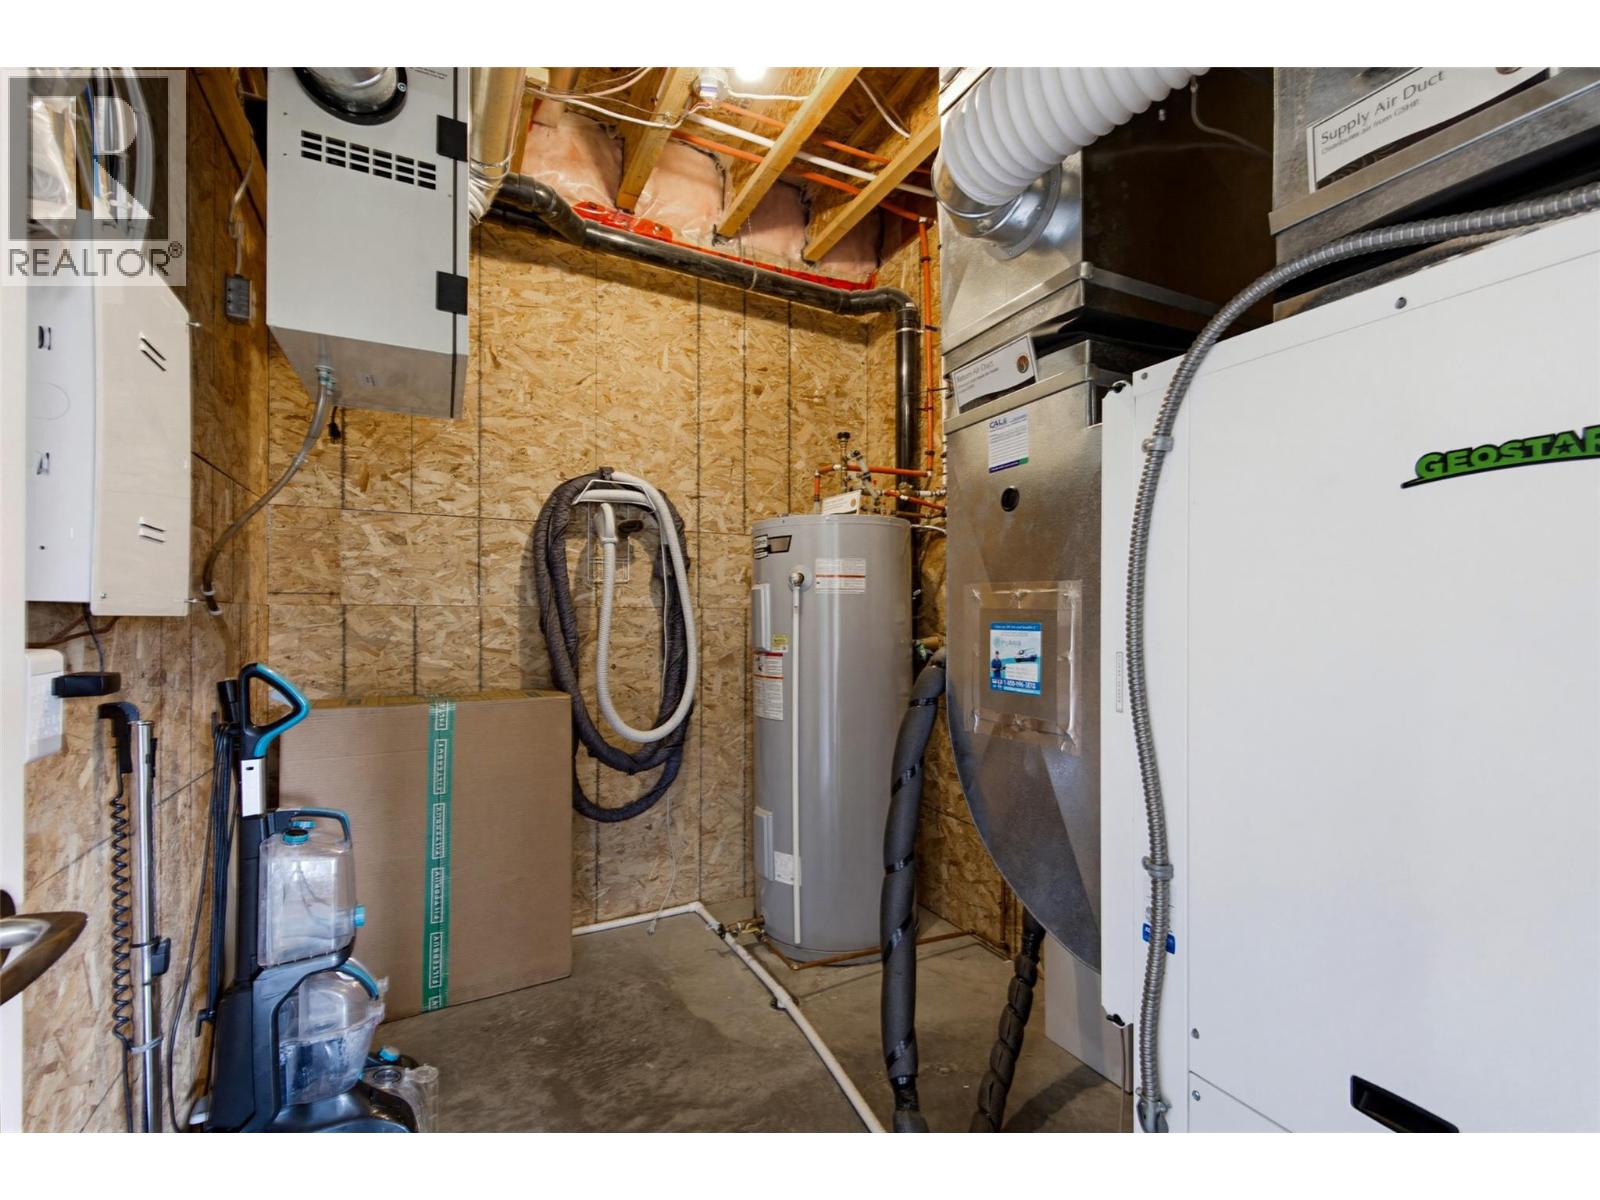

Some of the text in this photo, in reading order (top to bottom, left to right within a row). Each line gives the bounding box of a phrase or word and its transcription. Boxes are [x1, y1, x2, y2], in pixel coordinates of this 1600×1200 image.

[1320, 70, 1446, 144] Supply Air Duct
[431, 934, 441, 986] FILTERBUY
